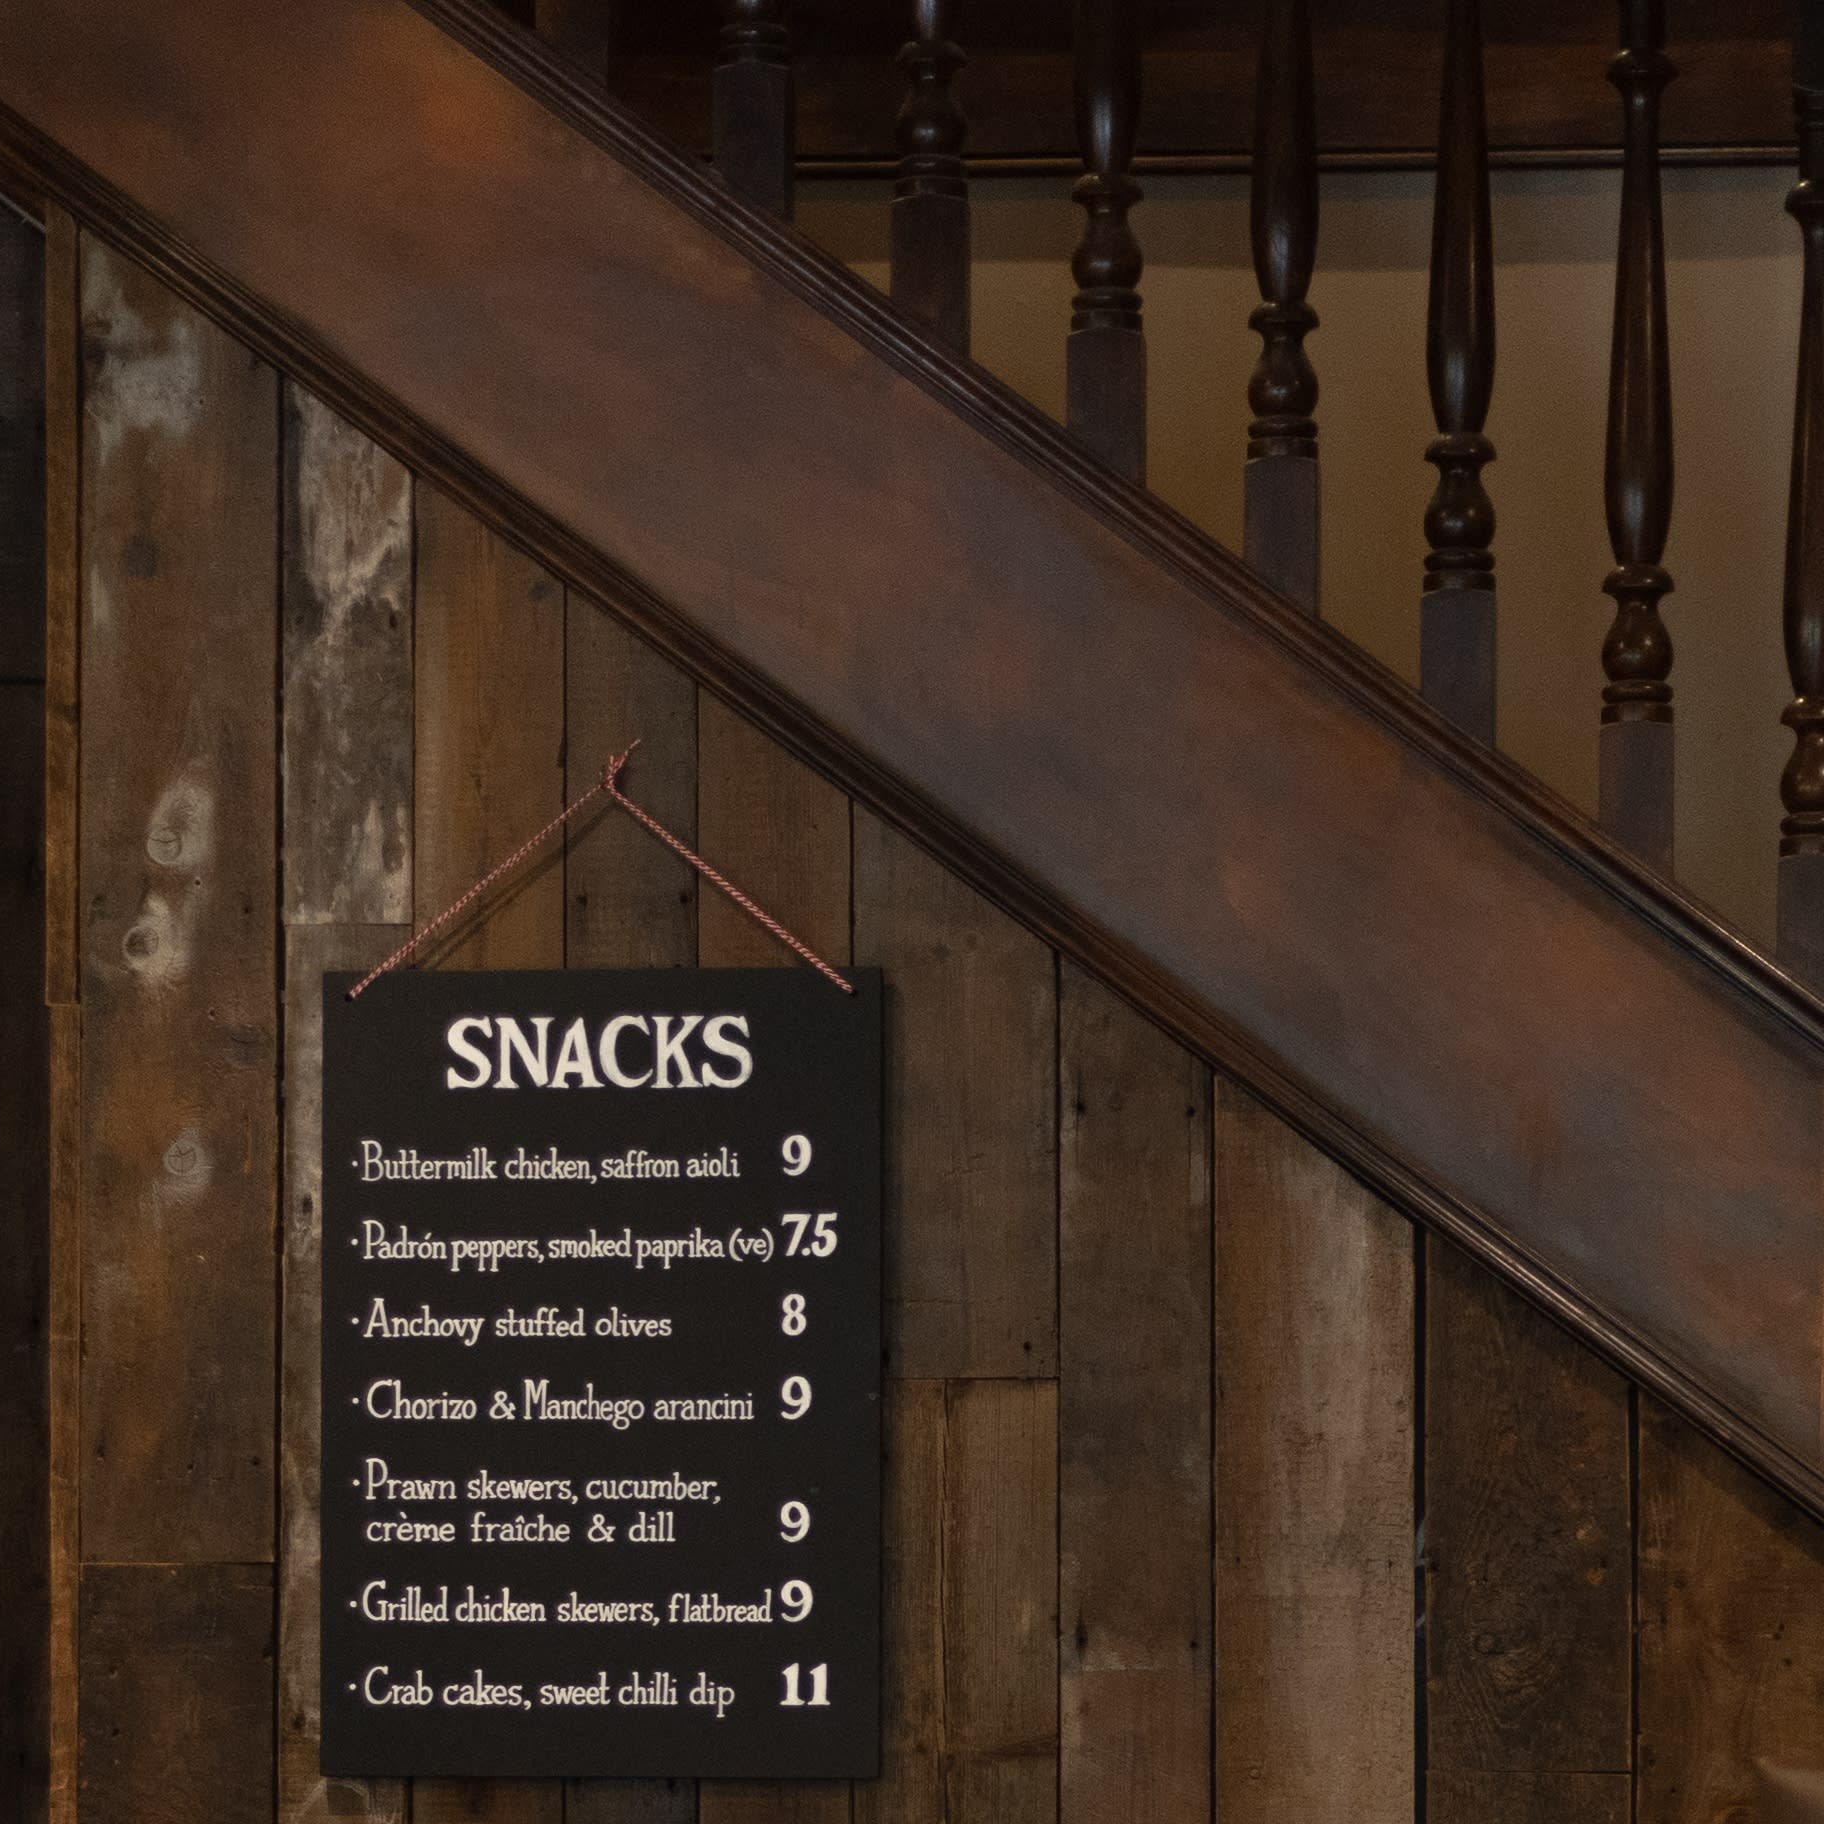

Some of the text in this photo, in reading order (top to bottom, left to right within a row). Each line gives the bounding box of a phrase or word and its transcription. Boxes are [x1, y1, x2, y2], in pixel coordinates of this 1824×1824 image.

[447, 1015, 753, 1089] SNACKS
[361, 1134, 812, 1184] Buttermilk chicken, saffron aioli 9
[362, 1212, 837, 1272] Padrón peppers, smoked paprika (ve) 7.5
[363, 1294, 806, 1346] Anchovy stuffed olives 8
[367, 1376, 812, 1430] Chorizo & Manchego arancini 9
[365, 1458, 720, 1504] Prawn skewers, cucumber,
[366, 1501, 810, 1543] crème fraîche & dill 9
[362, 1580, 813, 1626] Grilled chicken skewers, flatbread 9
[364, 1663, 830, 1718] Crab cakes, sweet chilli dip 11
